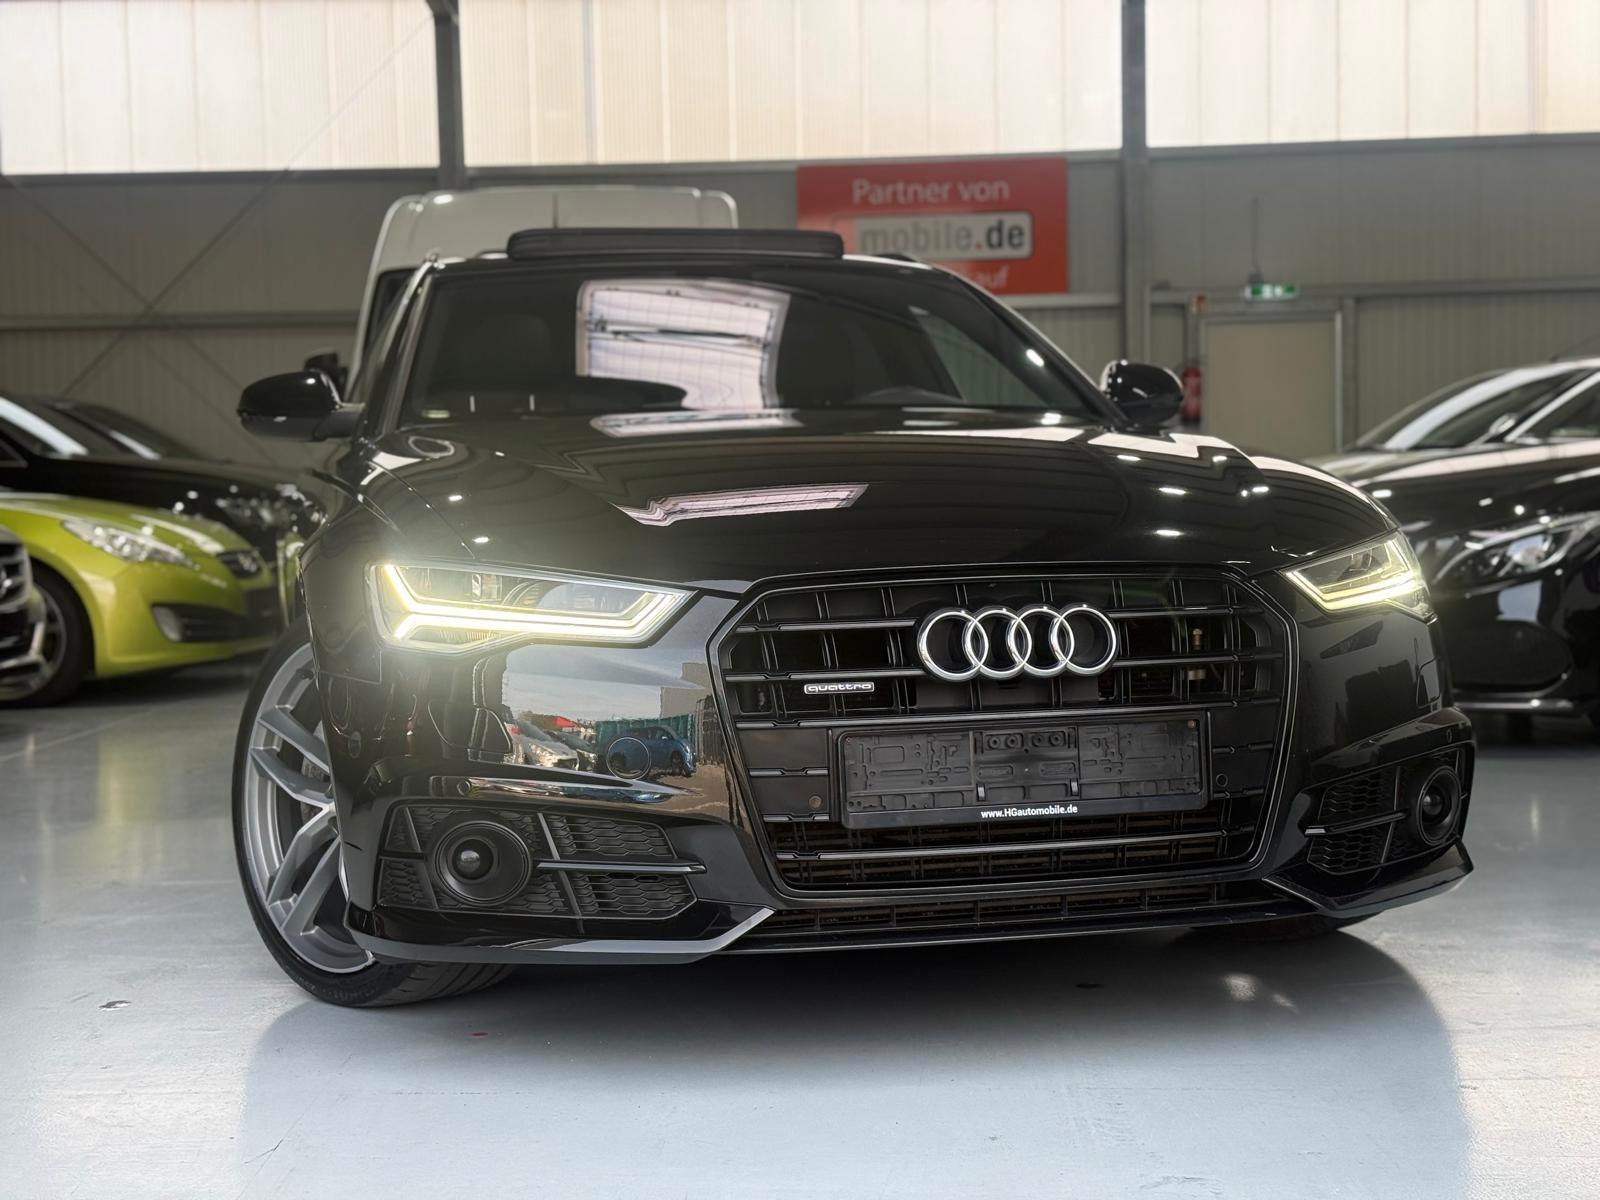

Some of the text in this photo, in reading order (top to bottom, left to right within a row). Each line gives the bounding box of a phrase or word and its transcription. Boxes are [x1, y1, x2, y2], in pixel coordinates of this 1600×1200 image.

[852, 178, 1010, 205] Partner von
[860, 218, 1025, 253] mobile.de
[807, 683, 872, 693] quattro
[980, 804, 1078, 819] www.HGautomobile.de
